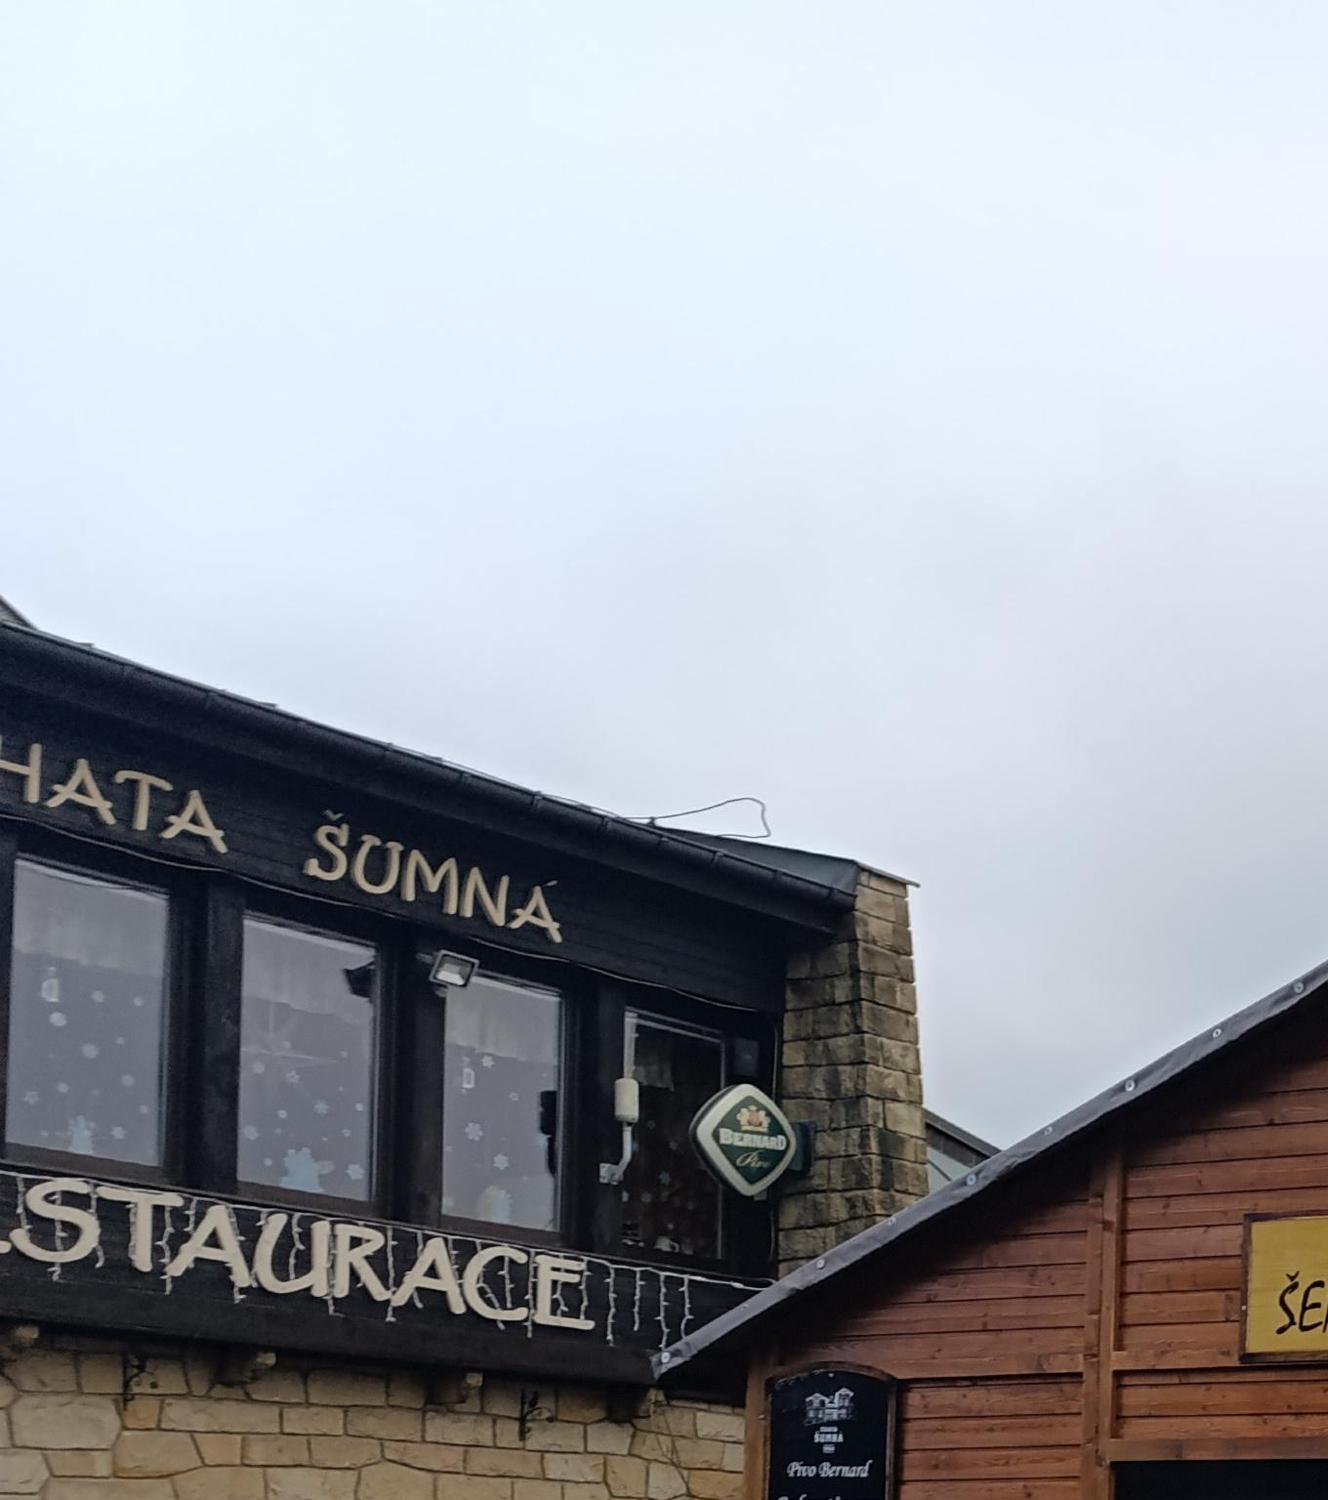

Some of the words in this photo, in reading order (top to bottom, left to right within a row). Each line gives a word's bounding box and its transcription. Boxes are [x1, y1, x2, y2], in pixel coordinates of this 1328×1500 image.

[303, 809, 563, 944] ŠUMNÁ
[719, 1128, 787, 1151] BERNARD
[0, 1177, 596, 1331] STAURACE
[819, 1459, 873, 1478] Bernard
